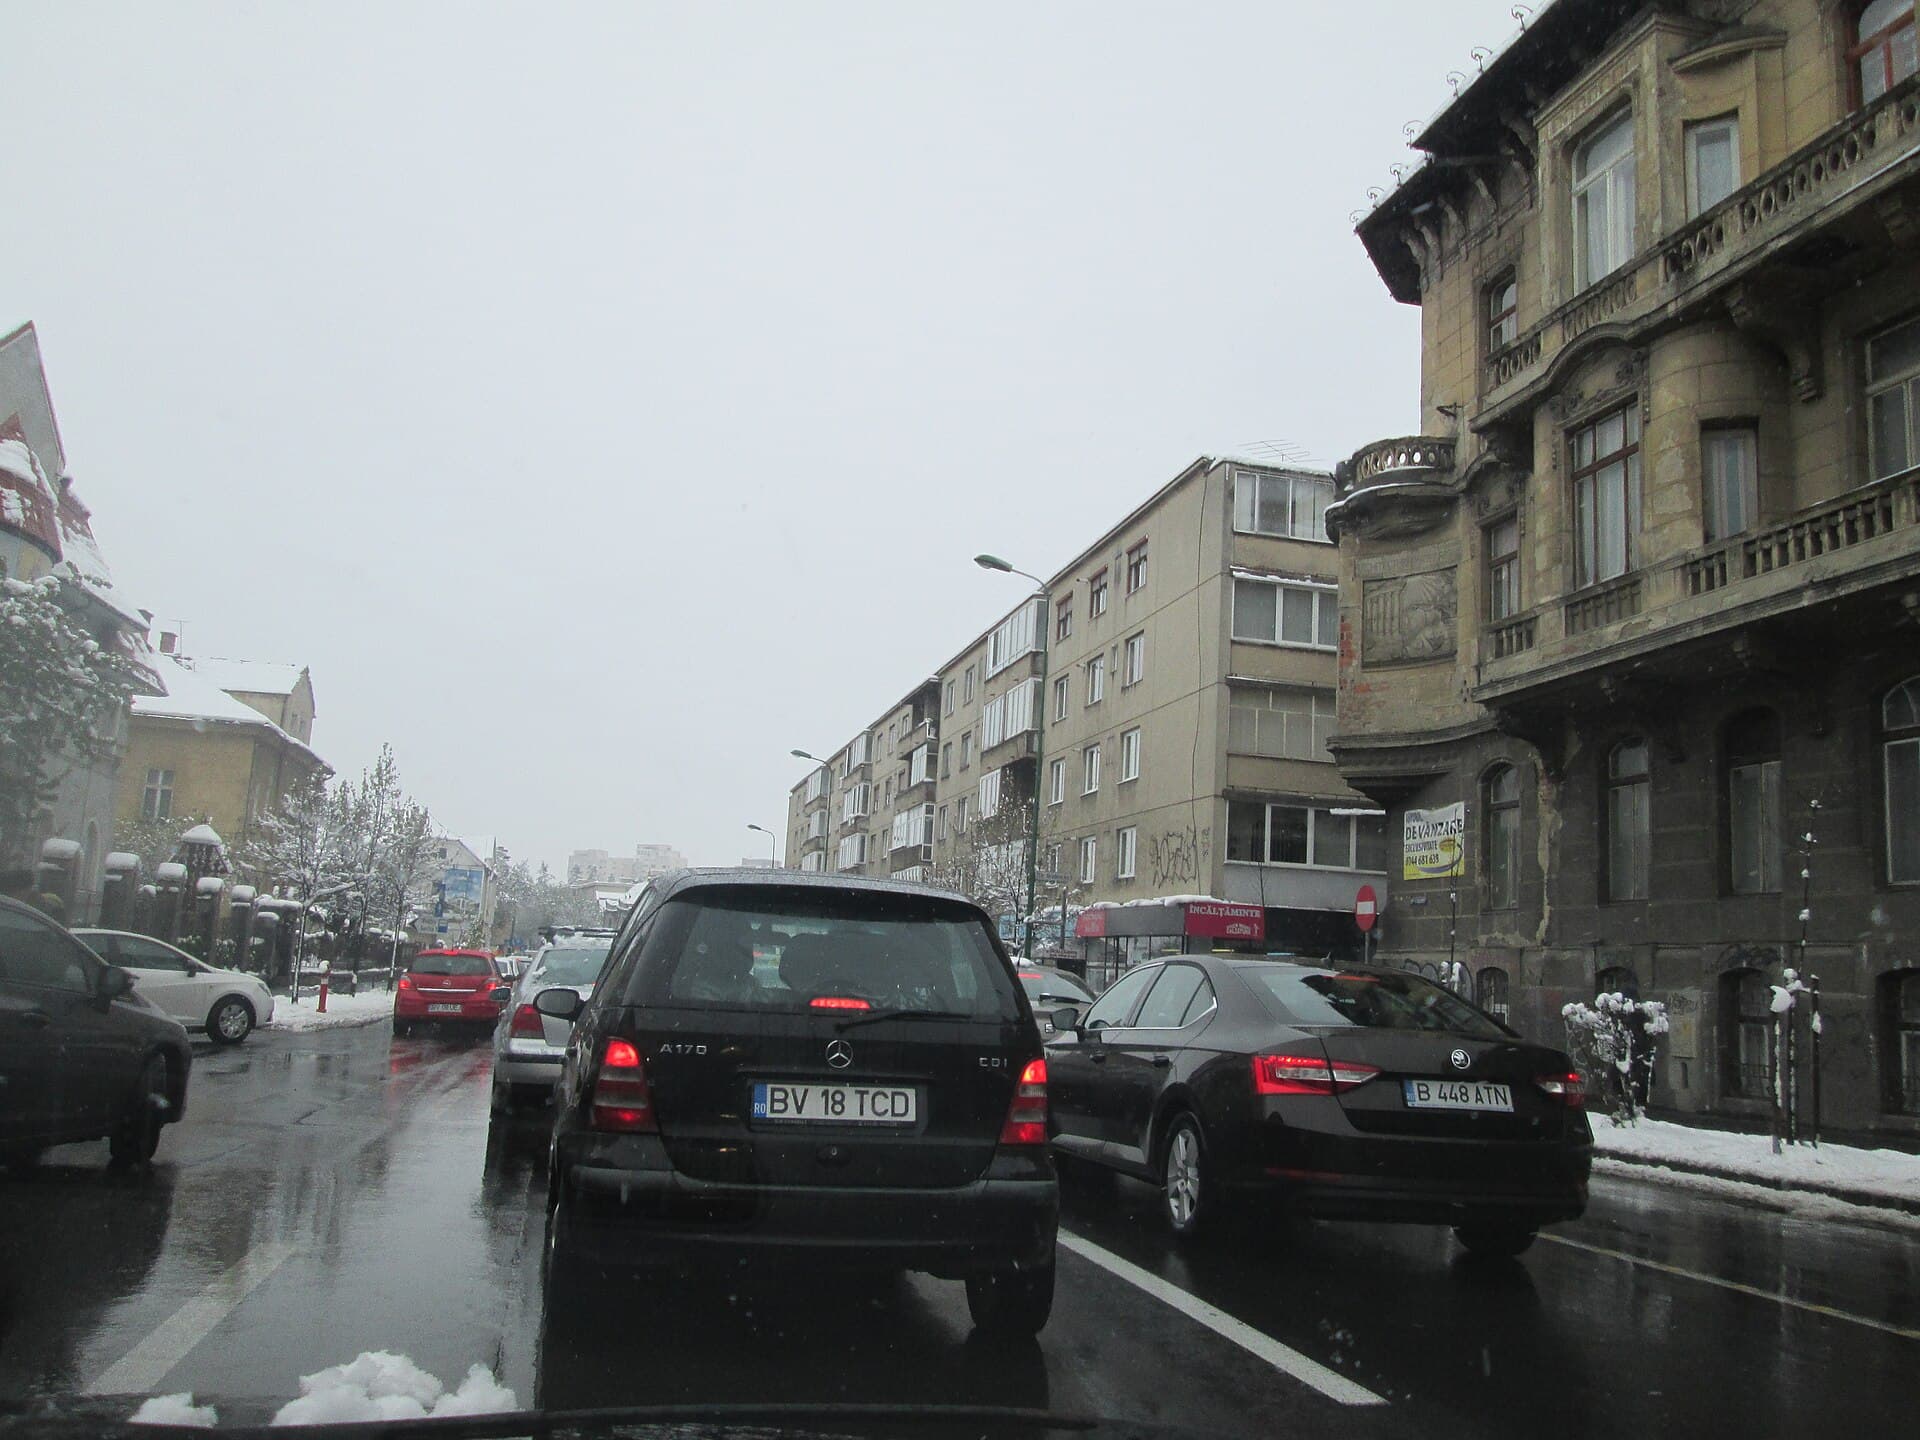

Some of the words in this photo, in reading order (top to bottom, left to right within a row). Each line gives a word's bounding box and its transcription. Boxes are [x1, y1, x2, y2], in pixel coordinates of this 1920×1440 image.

[1405, 826, 1417, 841] DE
[979, 1057, 1008, 1068] CDI
[1416, 1083, 1431, 1101] B
[1438, 1084, 1470, 1103] 448
[1474, 1085, 1508, 1105] ATN
[753, 1103, 767, 1114] RO
[769, 1087, 809, 1115] BV
[821, 1088, 846, 1116] 18
[854, 1089, 910, 1117] TCD
